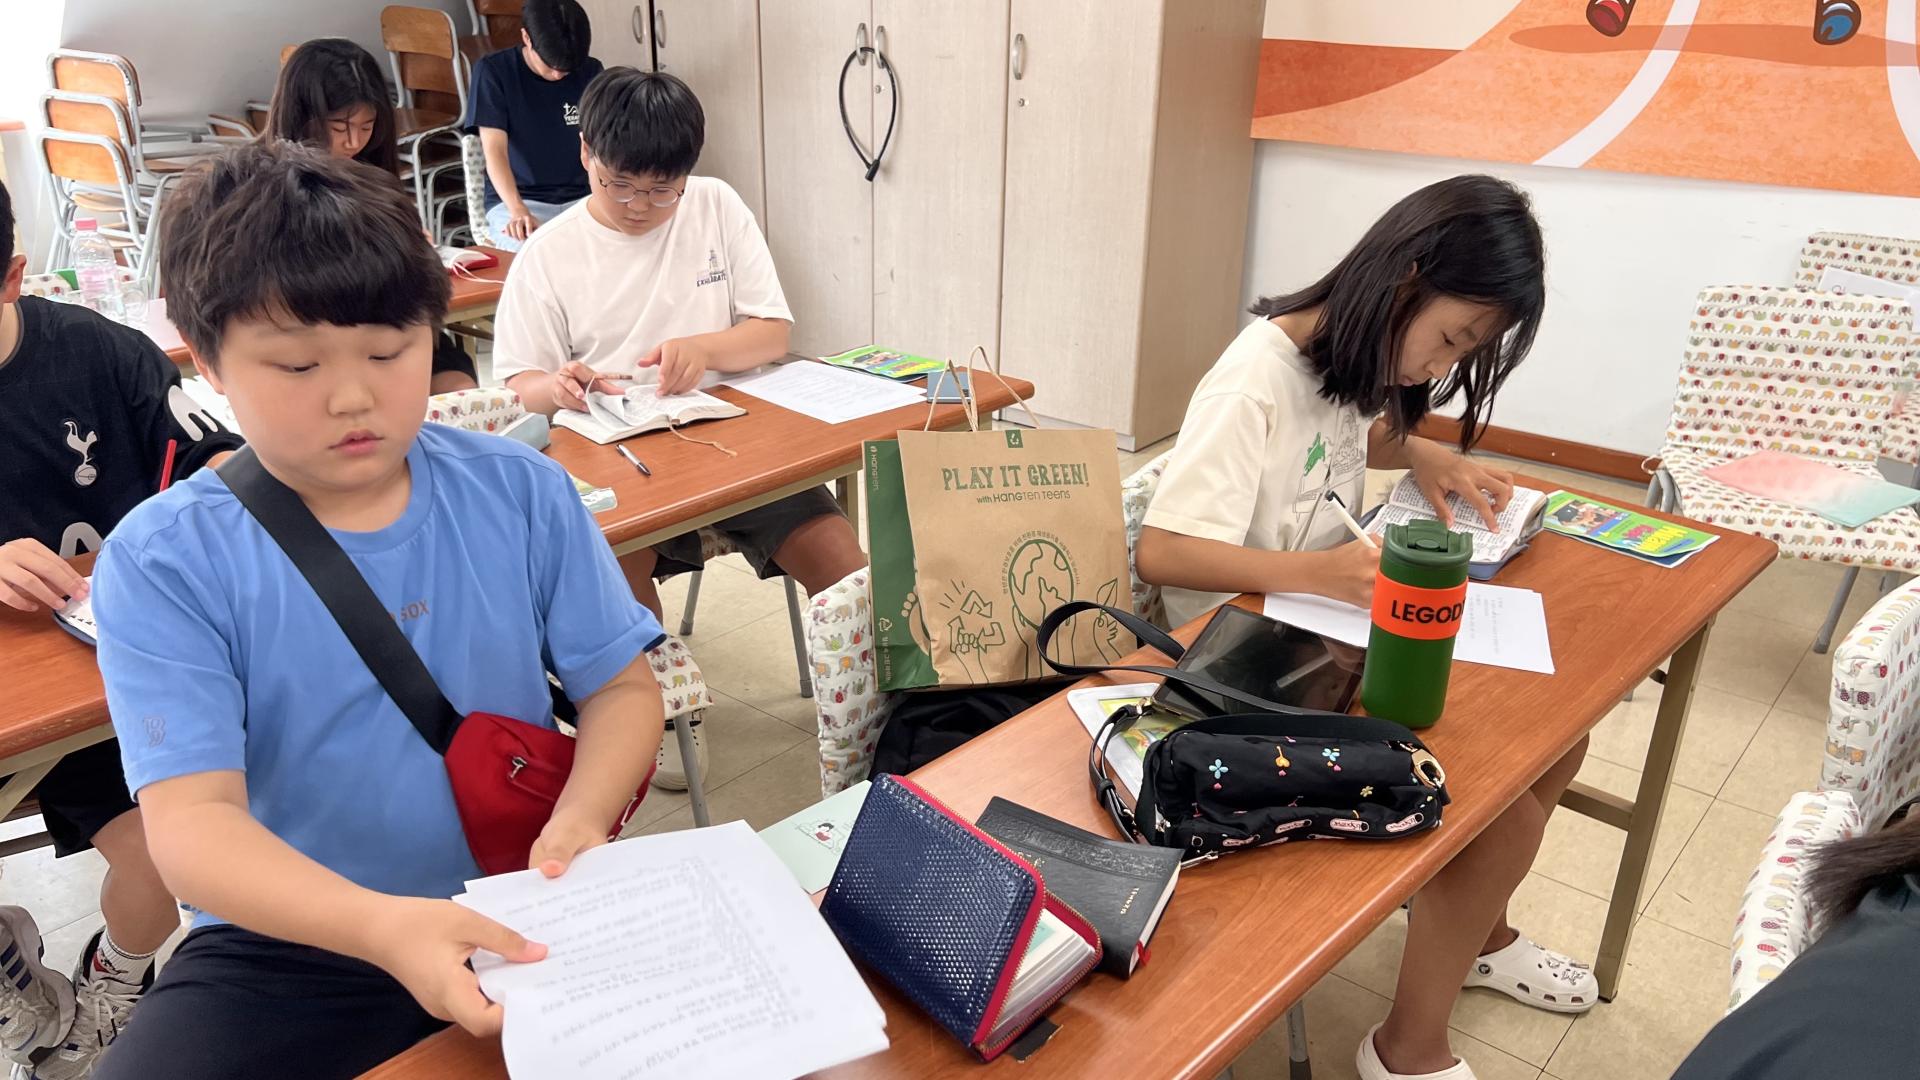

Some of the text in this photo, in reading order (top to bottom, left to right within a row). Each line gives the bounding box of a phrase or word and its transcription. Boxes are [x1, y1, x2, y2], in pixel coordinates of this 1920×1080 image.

[940, 462, 1090, 491] PLAY IT GREEN!
[976, 494, 993, 504] with
[400, 599, 430, 622] SOX
[142, 713, 166, 749] B
